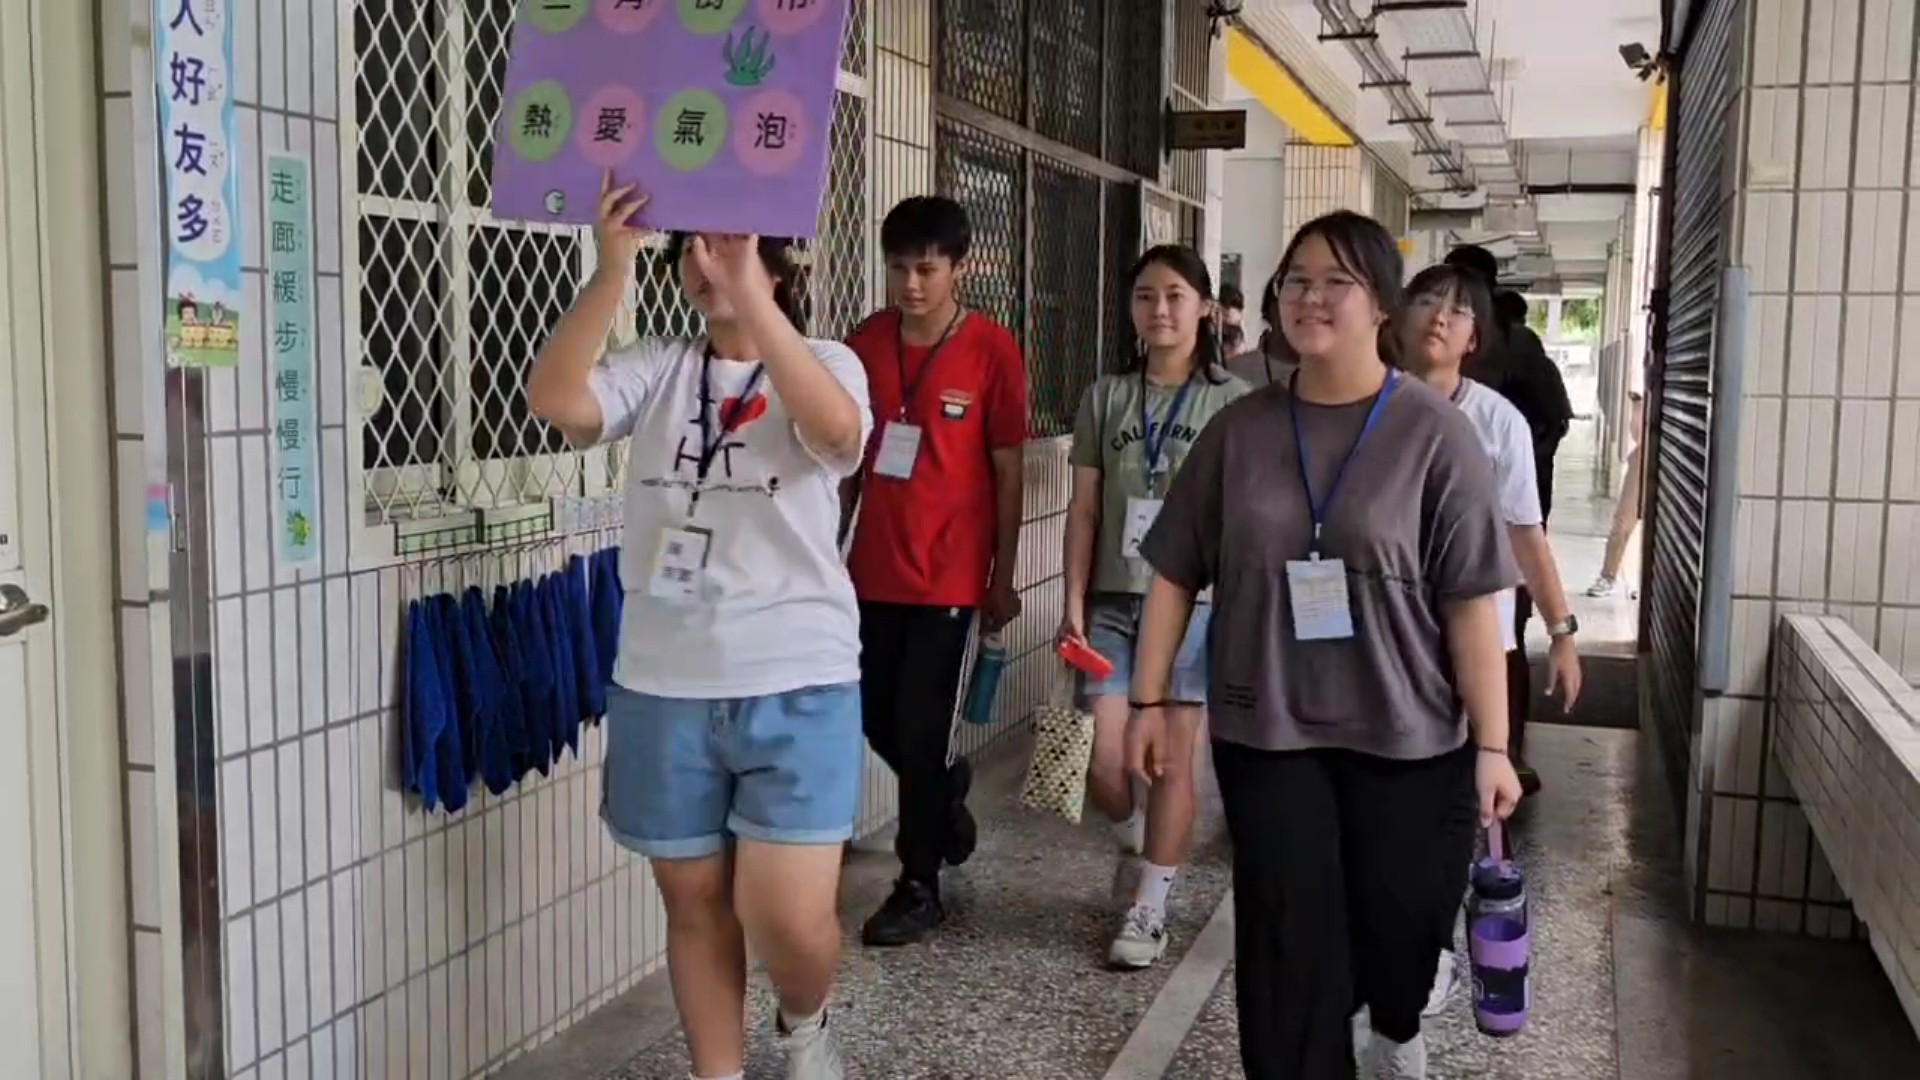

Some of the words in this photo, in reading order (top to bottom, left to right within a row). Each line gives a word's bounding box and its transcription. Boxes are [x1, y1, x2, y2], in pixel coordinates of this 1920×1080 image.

[170, 0, 208, 242] 人好友多
[523, 103, 787, 149] 熱愛氣泡
[271, 170, 301, 500] 走廊緩步慢慢行
